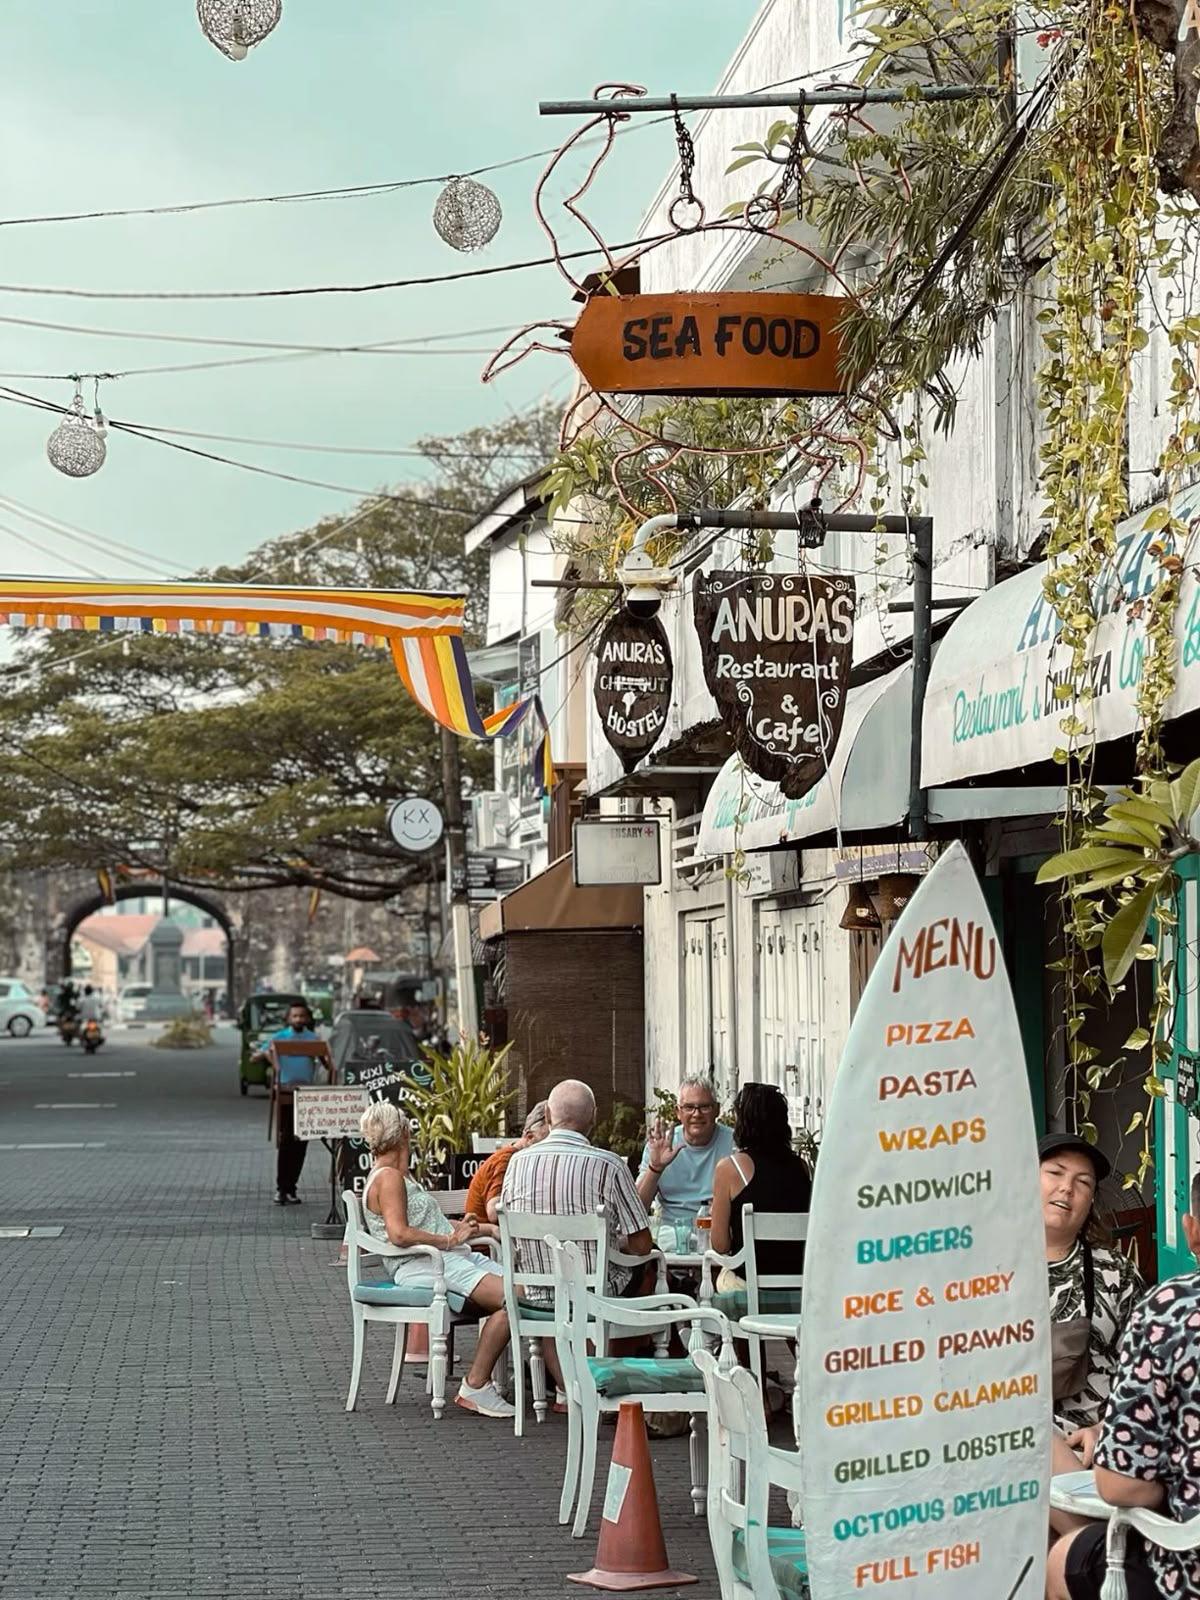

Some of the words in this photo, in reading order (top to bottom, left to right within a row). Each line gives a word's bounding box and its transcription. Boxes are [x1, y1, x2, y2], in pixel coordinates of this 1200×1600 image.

[622, 315, 702, 361] SEA
[714, 315, 821, 360] FOOD
[711, 586, 853, 644] ANURA'S
[602, 639, 666, 664] ANURA'S
[716, 653, 839, 680] Restaurant
[606, 704, 665, 738] HOSTEL
[780, 694, 799, 715] &
[953, 655, 1029, 745] Restaurant
[755, 716, 822, 752] Cafe
[892, 917, 996, 994] MENU
[886, 1017, 976, 1047] PIZZA
[879, 1068, 978, 1101] PASTA
[879, 1117, 987, 1153] WRAPS
[857, 1169, 992, 1209] SANDWICH
[857, 1225, 973, 1264] BURGERS
[844, 1291, 904, 1319] RICE
[915, 1287, 935, 1307] &
[945, 1271, 1015, 1302] CURRY
[825, 1340, 925, 1374] GRILLED
[938, 1319, 1035, 1359] PRAWNS
[826, 1395, 923, 1428] GRILLED
[934, 1374, 1039, 1412] CALAMARI
[834, 1448, 930, 1484] GRILLED
[943, 1426, 1036, 1463] LOBSTER
[833, 1498, 945, 1541] OCTOPUS
[953, 1479, 1040, 1517] DEVILLED
[856, 1556, 918, 1588] FULL
[927, 1542, 980, 1574] FISH
